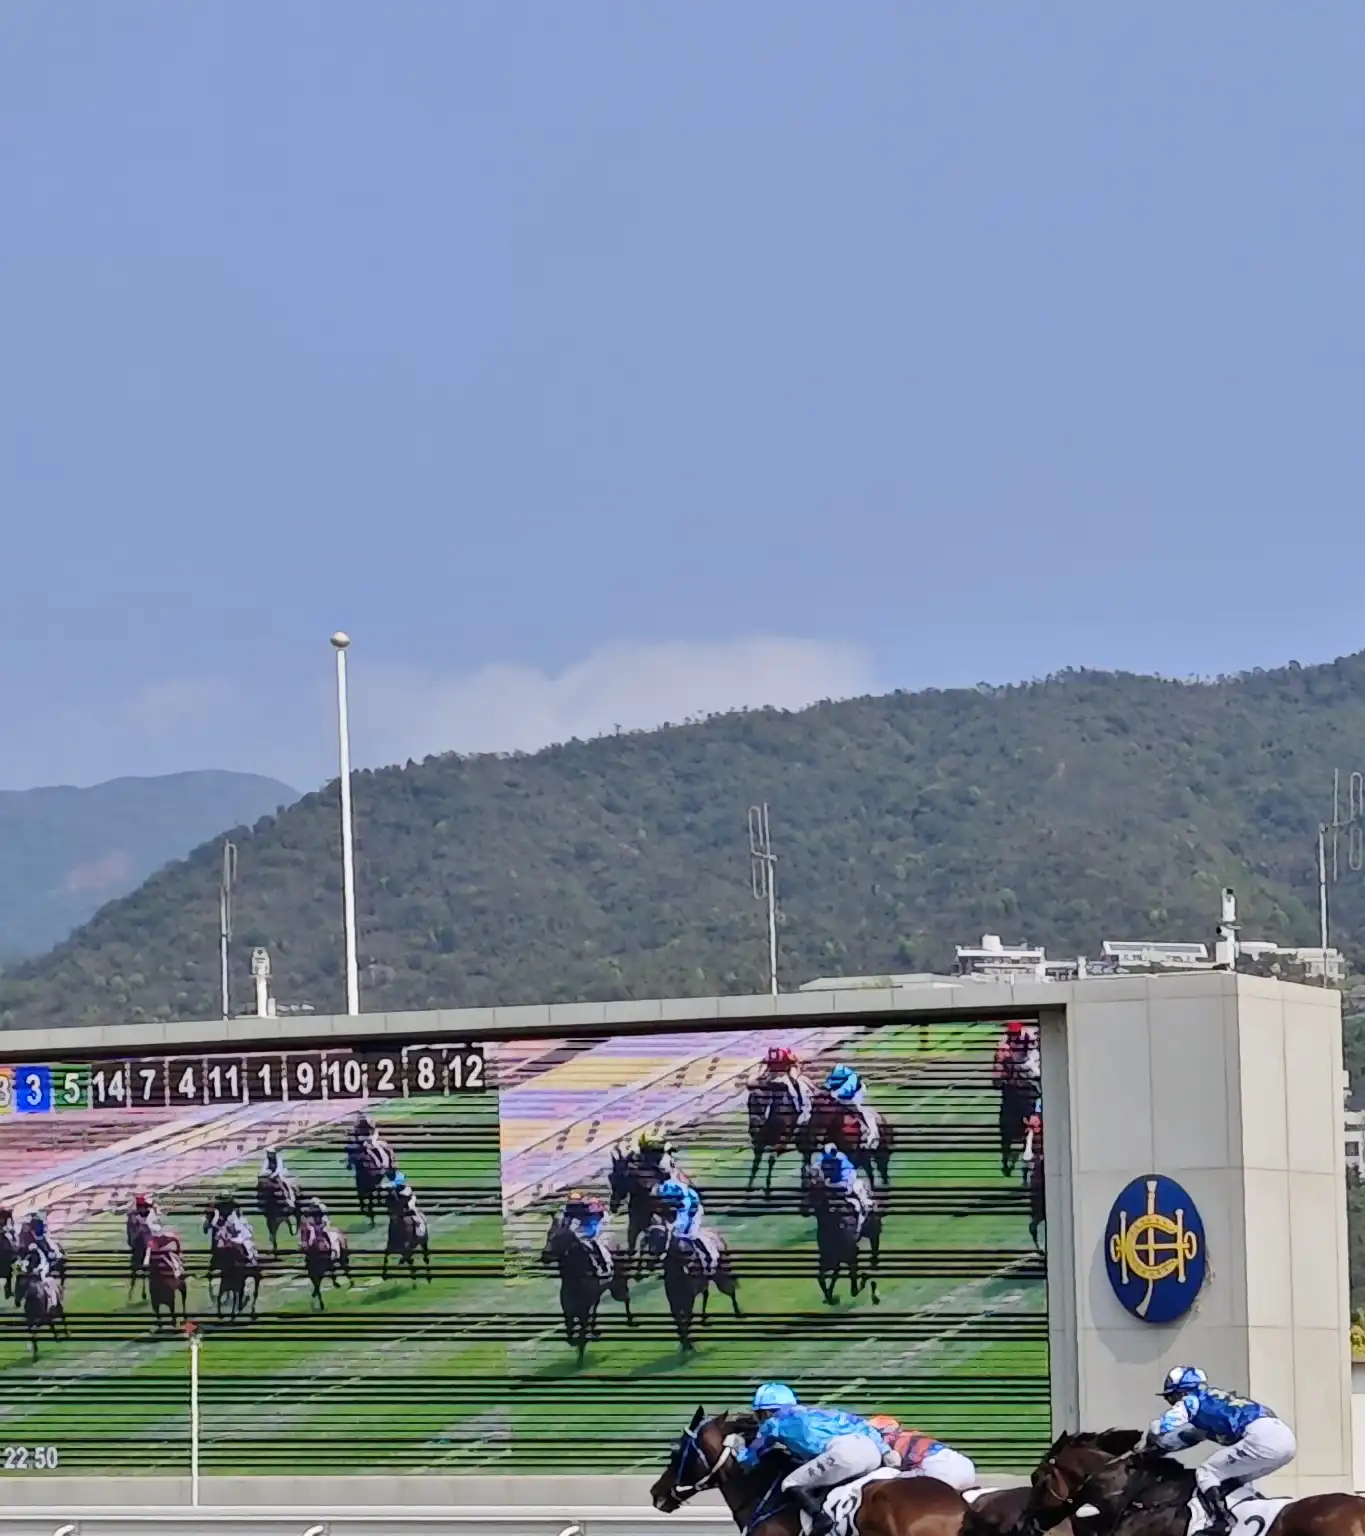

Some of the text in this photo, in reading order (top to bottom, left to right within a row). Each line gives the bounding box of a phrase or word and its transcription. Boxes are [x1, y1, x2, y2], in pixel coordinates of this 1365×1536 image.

[25, 1073, 43, 1105] 3
[63, 1072, 81, 1103] 5
[92, 1070, 125, 1102] 14
[139, 1068, 156, 1100] 7
[178, 1066, 197, 1099] 4
[208, 1064, 239, 1097] 11
[257, 1063, 272, 1096] 1
[296, 1062, 315, 1094] 9
[327, 1059, 362, 1092] 10
[377, 1058, 396, 1091] 2
[417, 1056, 436, 1089] 8
[448, 1054, 484, 1088] 12
